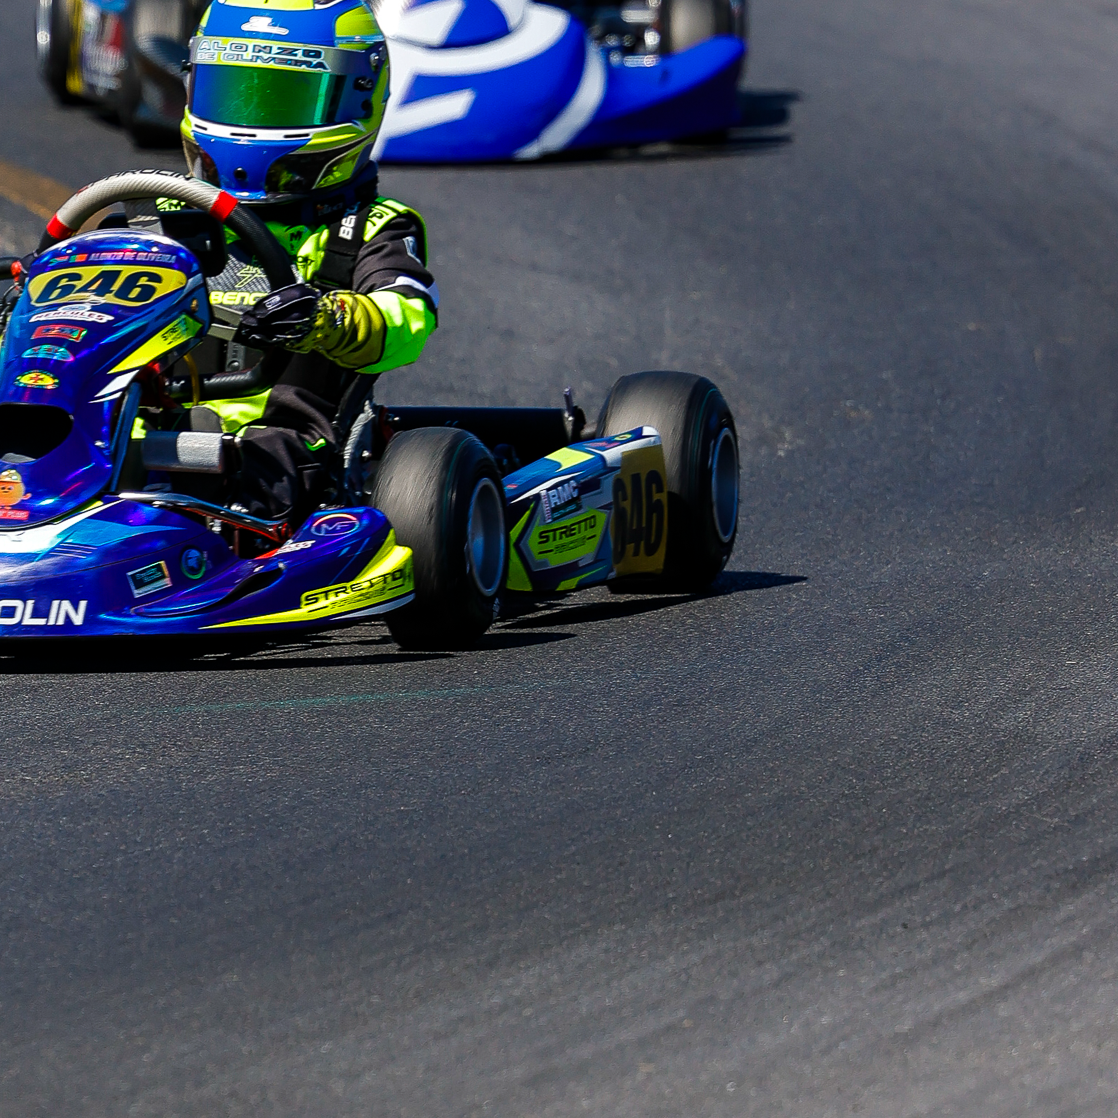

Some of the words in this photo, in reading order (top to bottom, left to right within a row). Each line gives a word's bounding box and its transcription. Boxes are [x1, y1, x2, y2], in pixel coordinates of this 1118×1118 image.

[196, 52, 216, 61] DE
[223, 53, 331, 70] OLIVEIRA
[199, 41, 323, 59] ALONZO
[35, 270, 163, 303] 646
[546, 480, 579, 508] RMC
[321, 522, 353, 535] MF
[538, 515, 597, 544] STRETTO
[612, 469, 665, 565] 646
[304, 569, 403, 606] STRETTO
